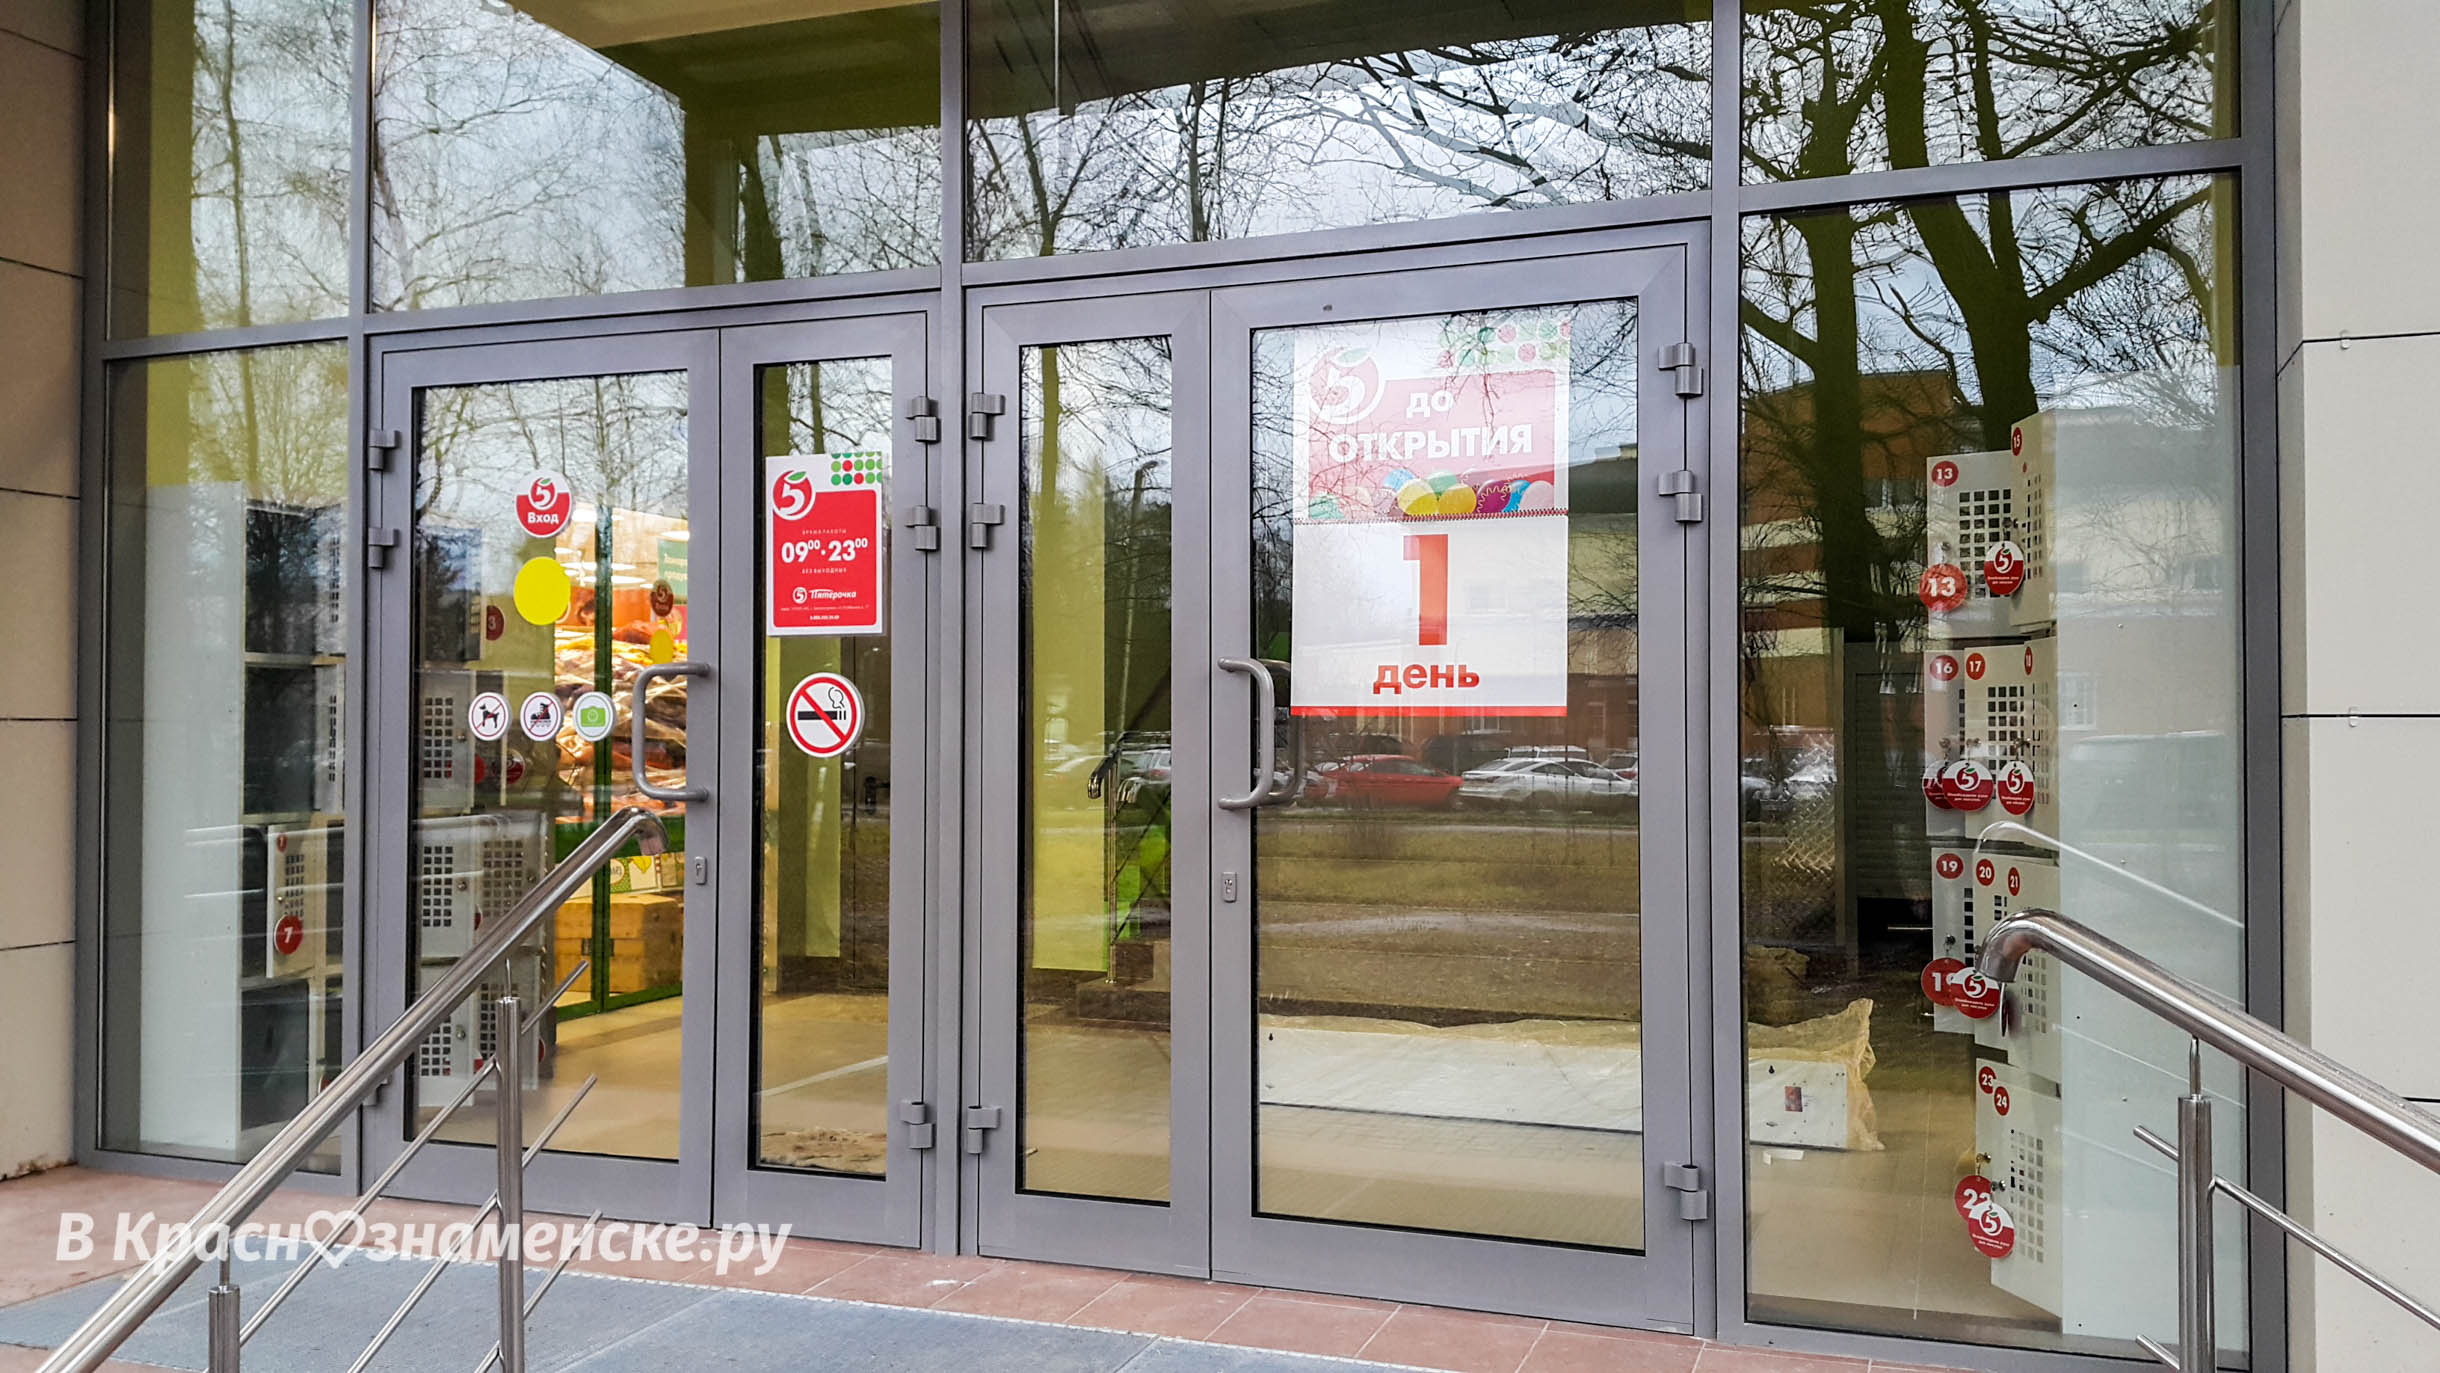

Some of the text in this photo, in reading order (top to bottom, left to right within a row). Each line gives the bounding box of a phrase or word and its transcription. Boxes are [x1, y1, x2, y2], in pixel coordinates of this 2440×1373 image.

[1328, 423, 1533, 463] ОТКРЫТИЯ
[2013, 435, 2021, 448] 15
[1936, 468, 1953, 480] 13
[527, 512, 559, 525] Вход
[1403, 534, 1449, 646] 1
[1928, 576, 1956, 597] 13
[1935, 662, 1953, 675] 16
[1969, 660, 1982, 673] 17
[1373, 664, 1480, 695] день
[1941, 860, 1958, 872] 19
[1979, 866, 1992, 880] 20
[2010, 875, 2019, 888] 21
[1981, 1073, 1993, 1087] 23
[1996, 1094, 2007, 1108] 24
